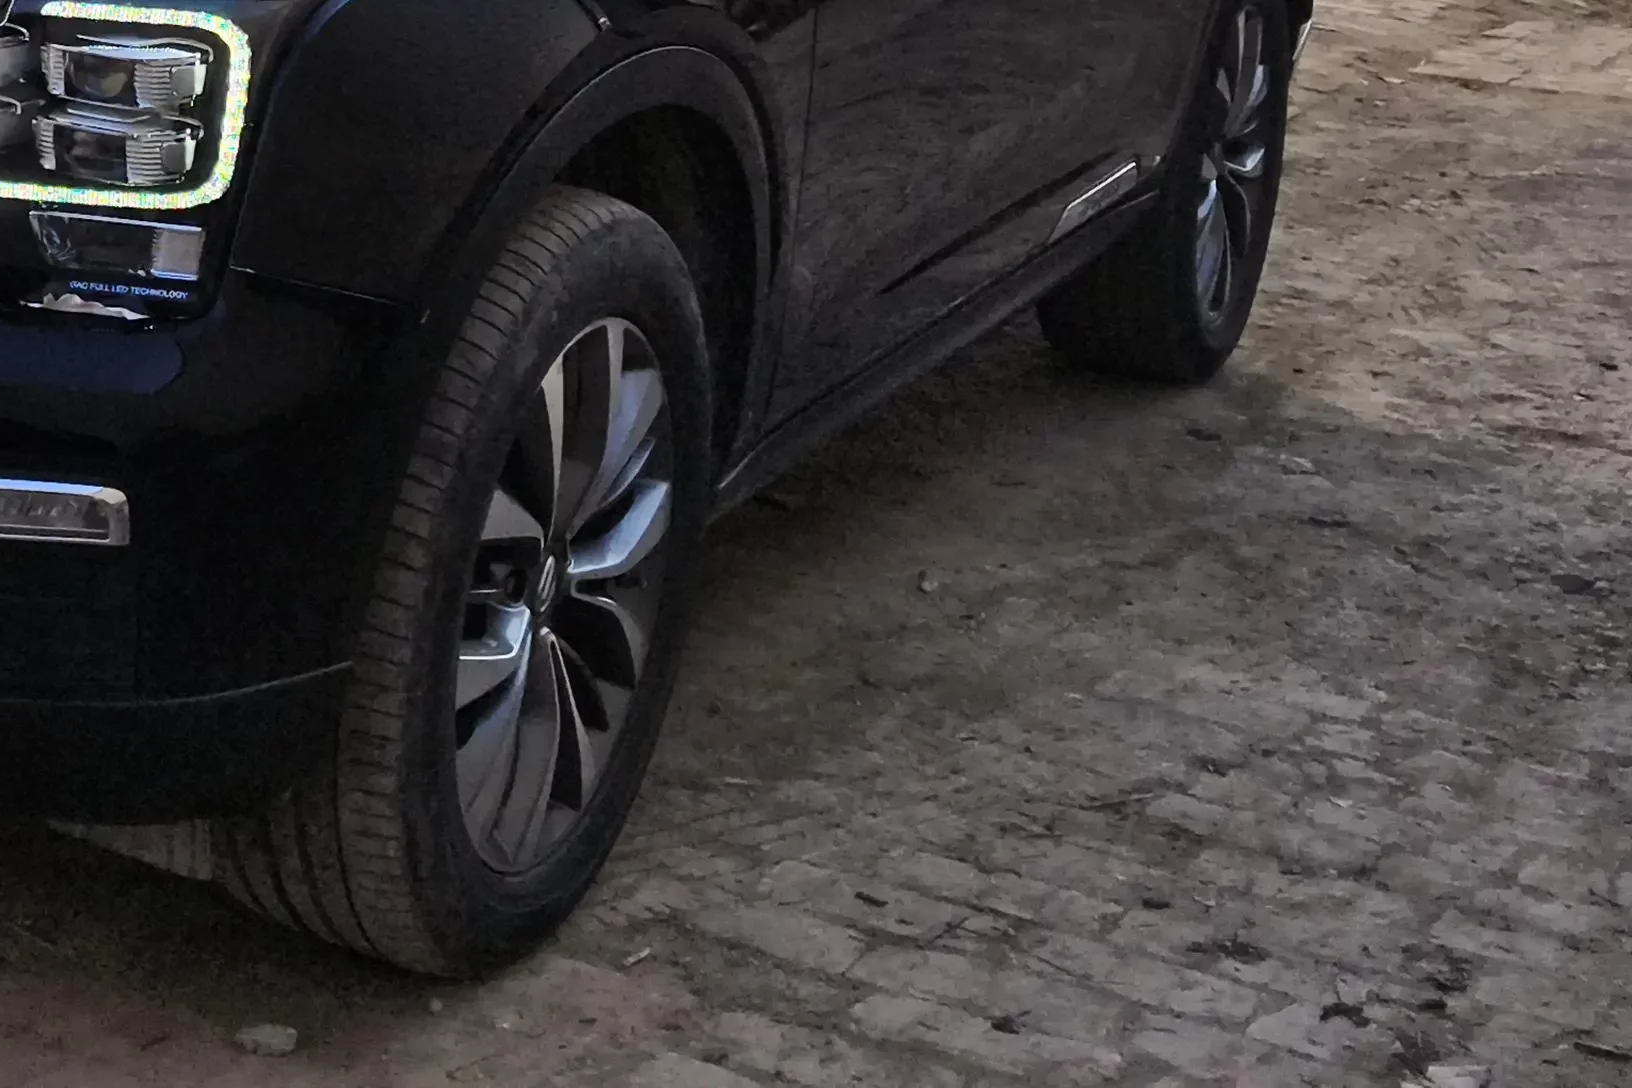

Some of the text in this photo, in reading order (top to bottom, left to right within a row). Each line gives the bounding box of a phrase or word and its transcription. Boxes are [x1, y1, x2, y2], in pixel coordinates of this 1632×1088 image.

[89, 283, 109, 292] FULL
[111, 285, 129, 293] LED
[131, 286, 188, 299] TECHNOLOGY
